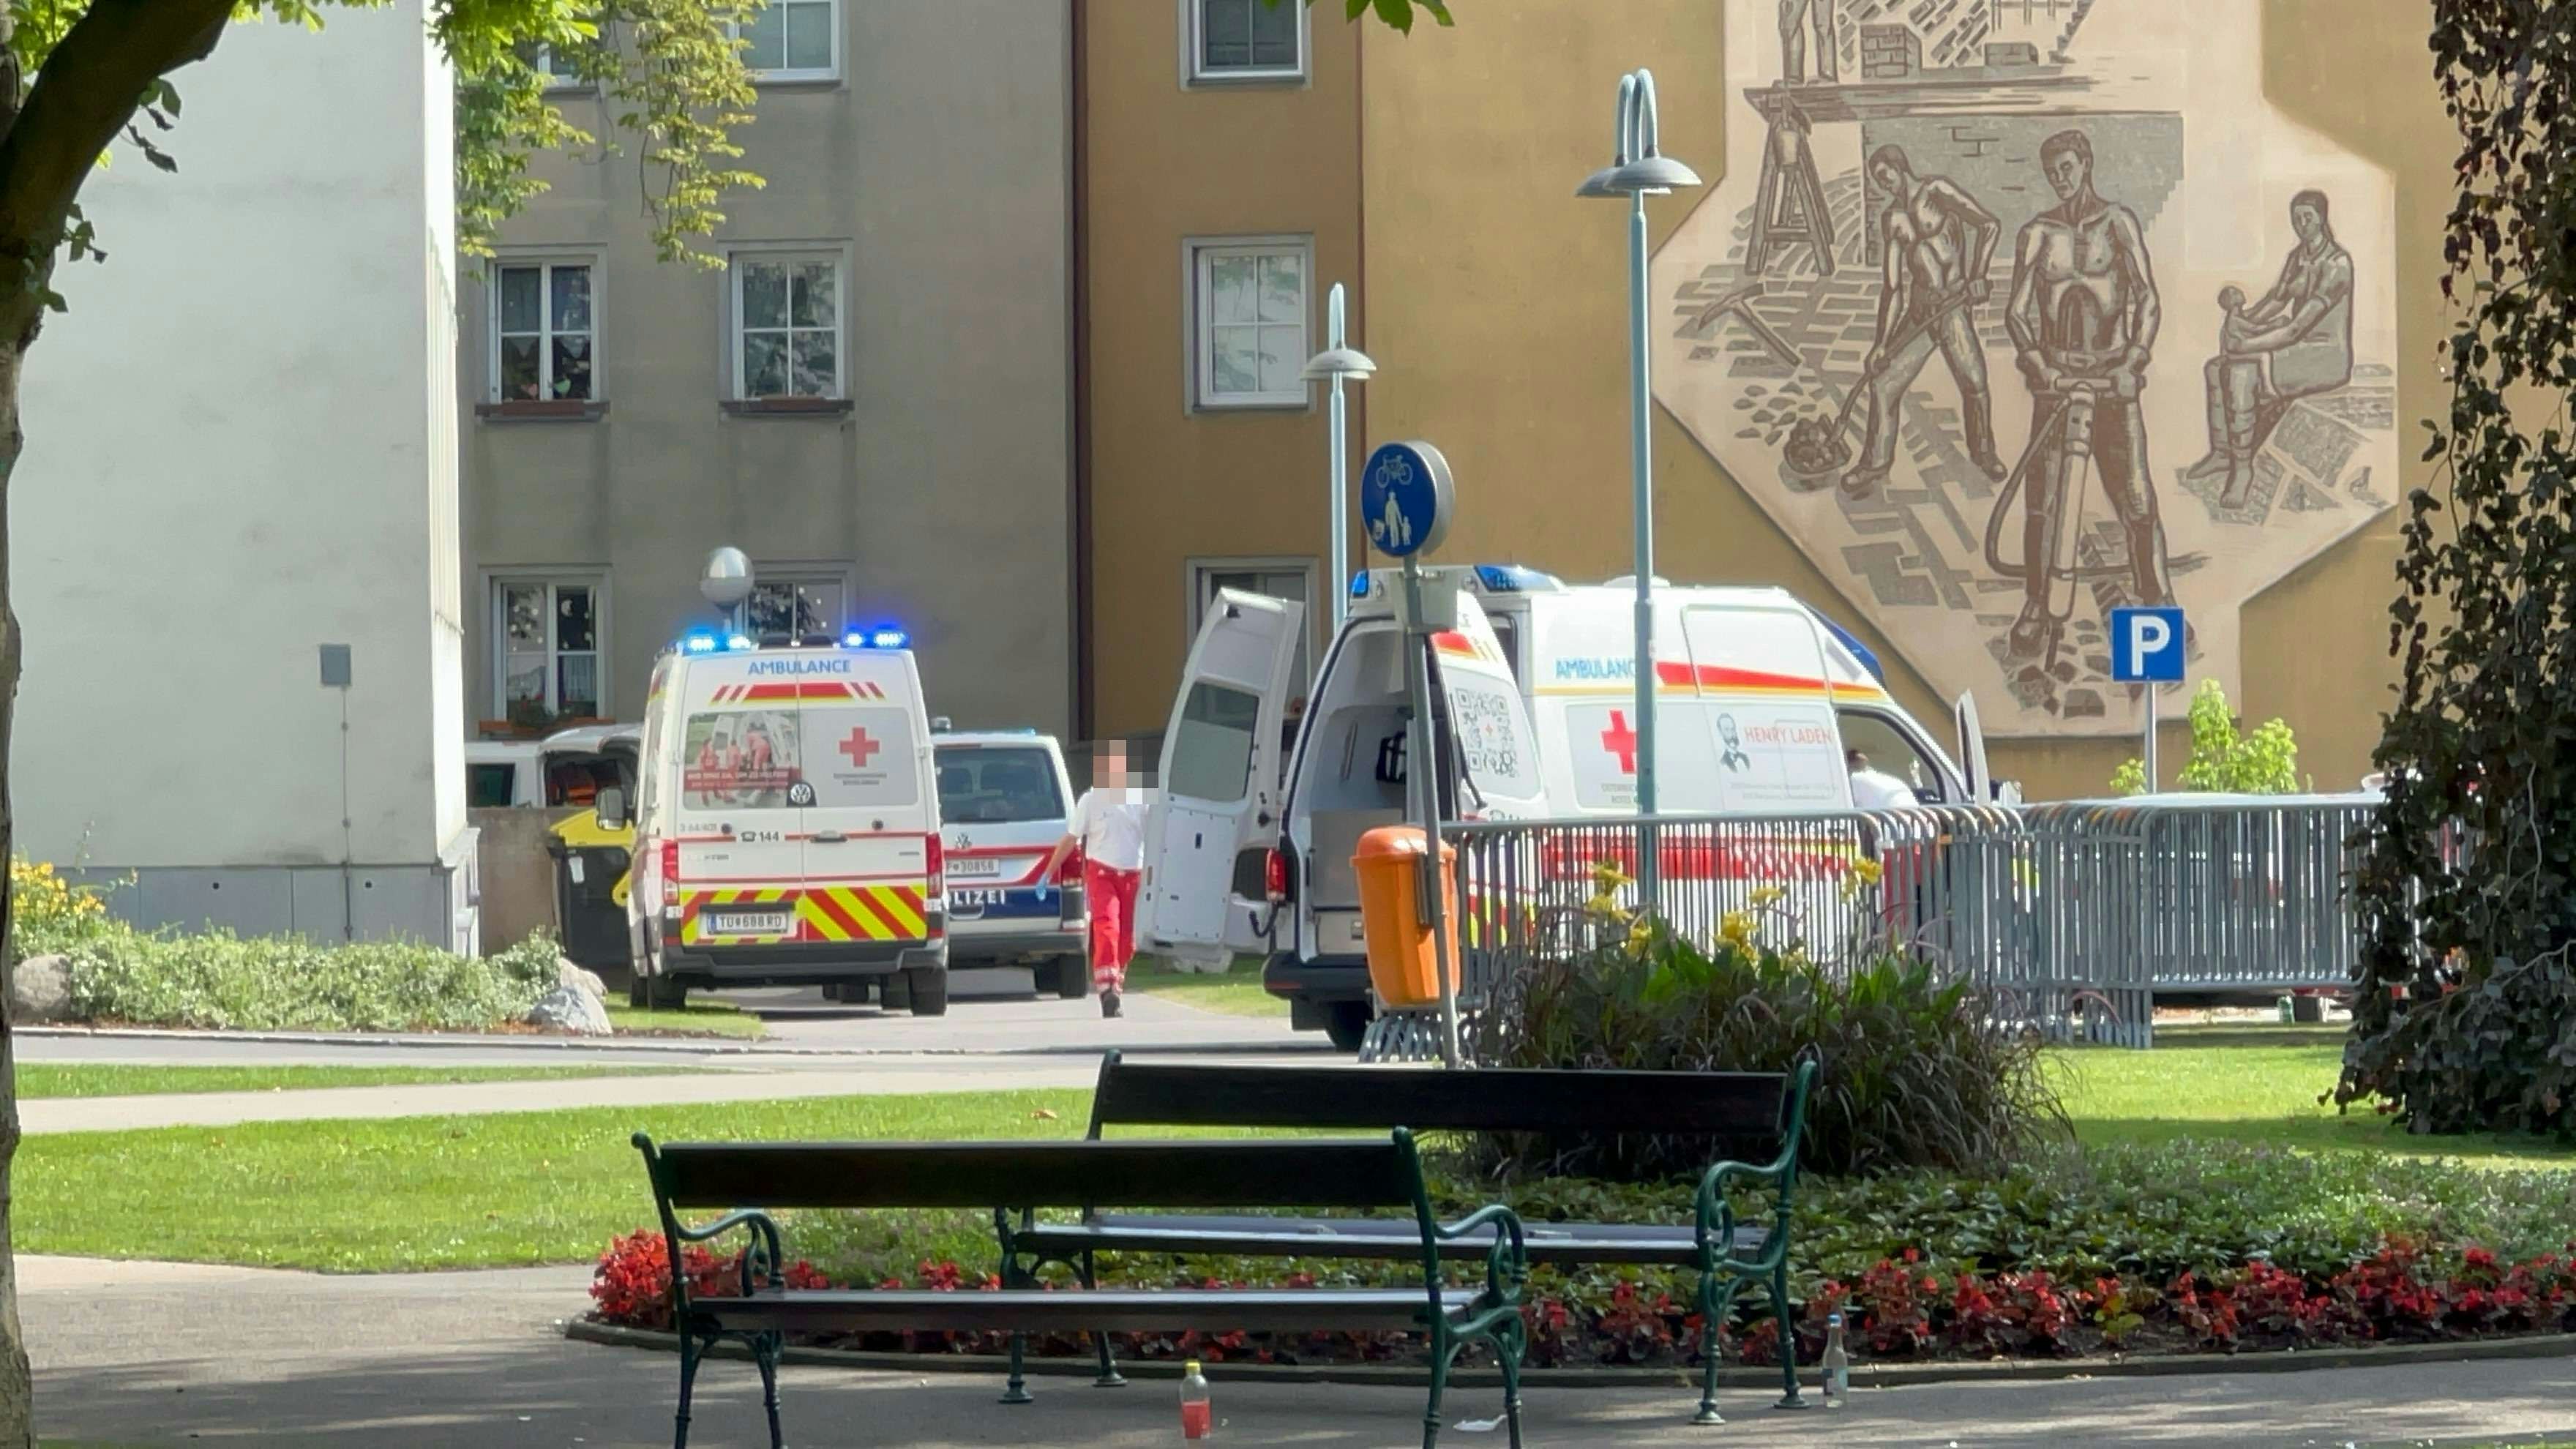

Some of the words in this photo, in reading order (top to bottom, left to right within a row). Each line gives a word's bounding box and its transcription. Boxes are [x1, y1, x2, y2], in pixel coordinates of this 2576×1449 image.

[2131, 615, 2171, 676] P
[748, 660, 851, 675] AMBULANCE
[1556, 658, 1636, 678] AMBULANC
[1744, 727, 1786, 744] HENRY
[1791, 727, 1833, 744] LADEN
[760, 831, 779, 842] 144
[954, 889, 1006, 905] LIZEI
